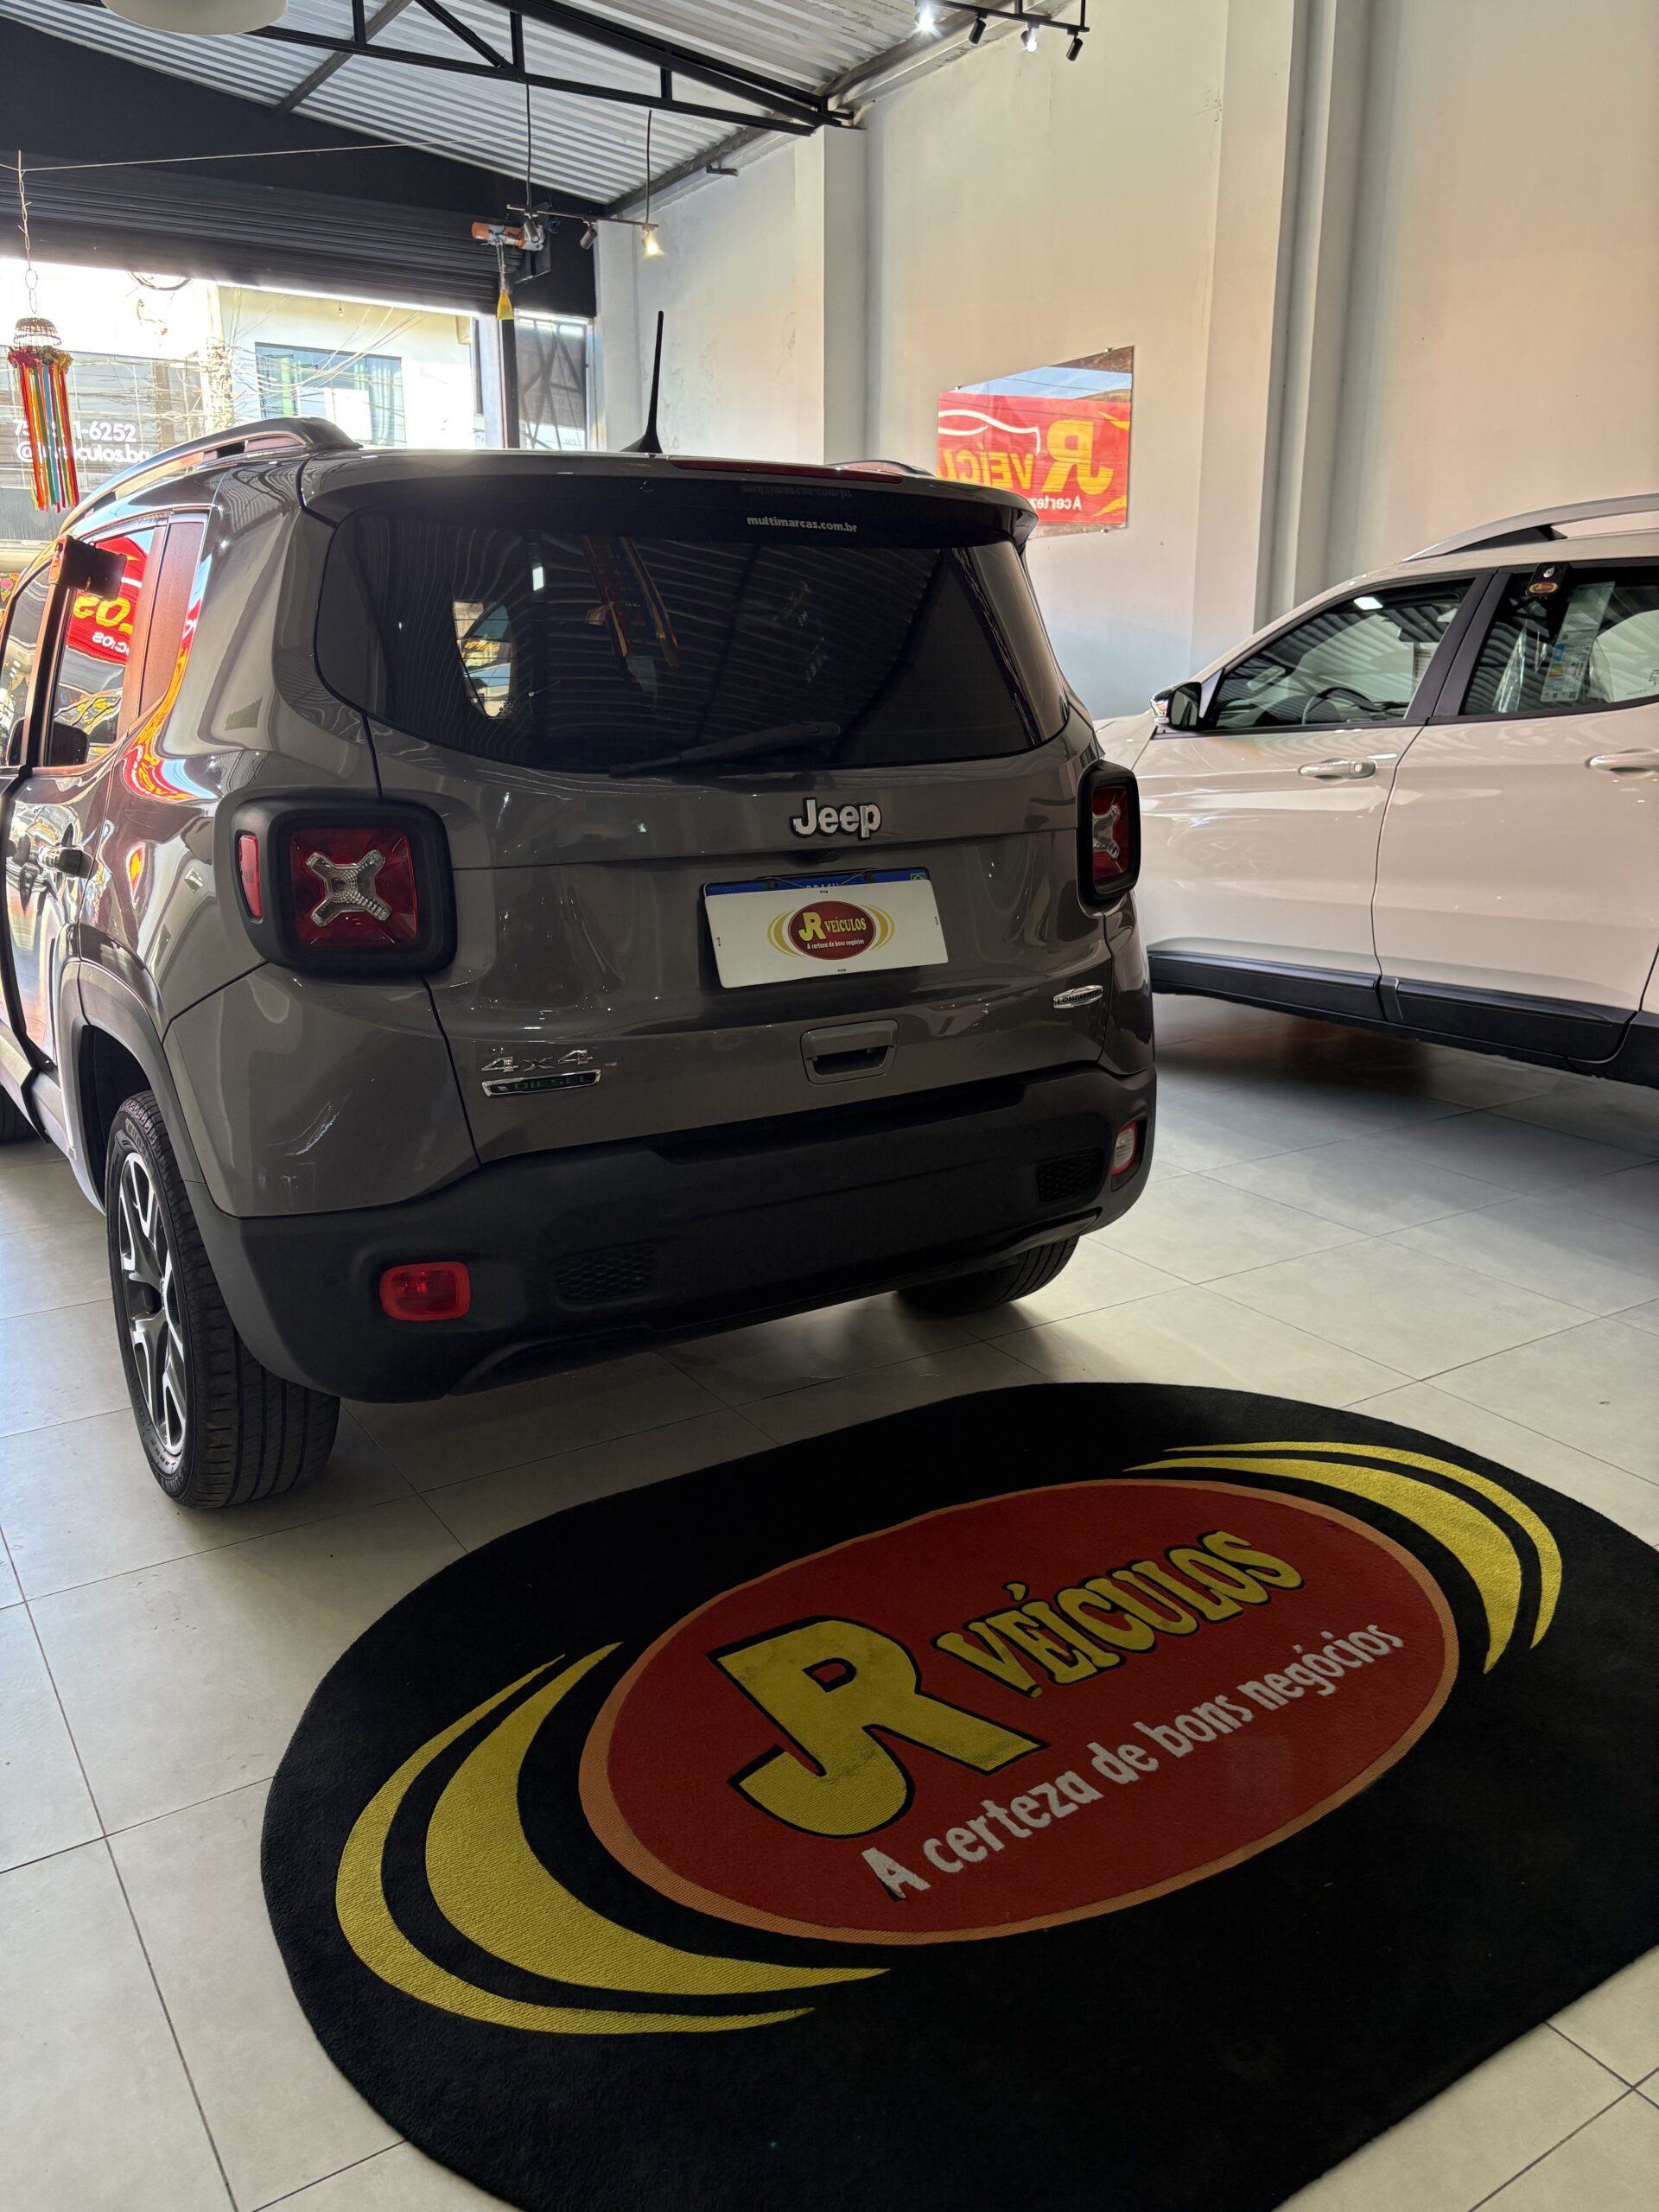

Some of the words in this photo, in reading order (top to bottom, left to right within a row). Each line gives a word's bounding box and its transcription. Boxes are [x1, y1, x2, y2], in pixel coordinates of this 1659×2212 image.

[747, 516, 858, 532] multimarcas.com.br
[790, 797, 882, 841] Jeep
[798, 912, 826, 942] JR
[824, 917, 867, 933] VEÍCULOS
[514, 1075, 590, 1092] DIESEL
[707, 1617, 1051, 1839] JR
[931, 1529, 1306, 1700] VEÍCULOS
[861, 1847, 931, 1900] A
[922, 1770, 1104, 1873] certeza
[1086, 1742, 1159, 1785] de
[1133, 1691, 1255, 1758] bons
[1236, 1624, 1405, 1711] negócios
